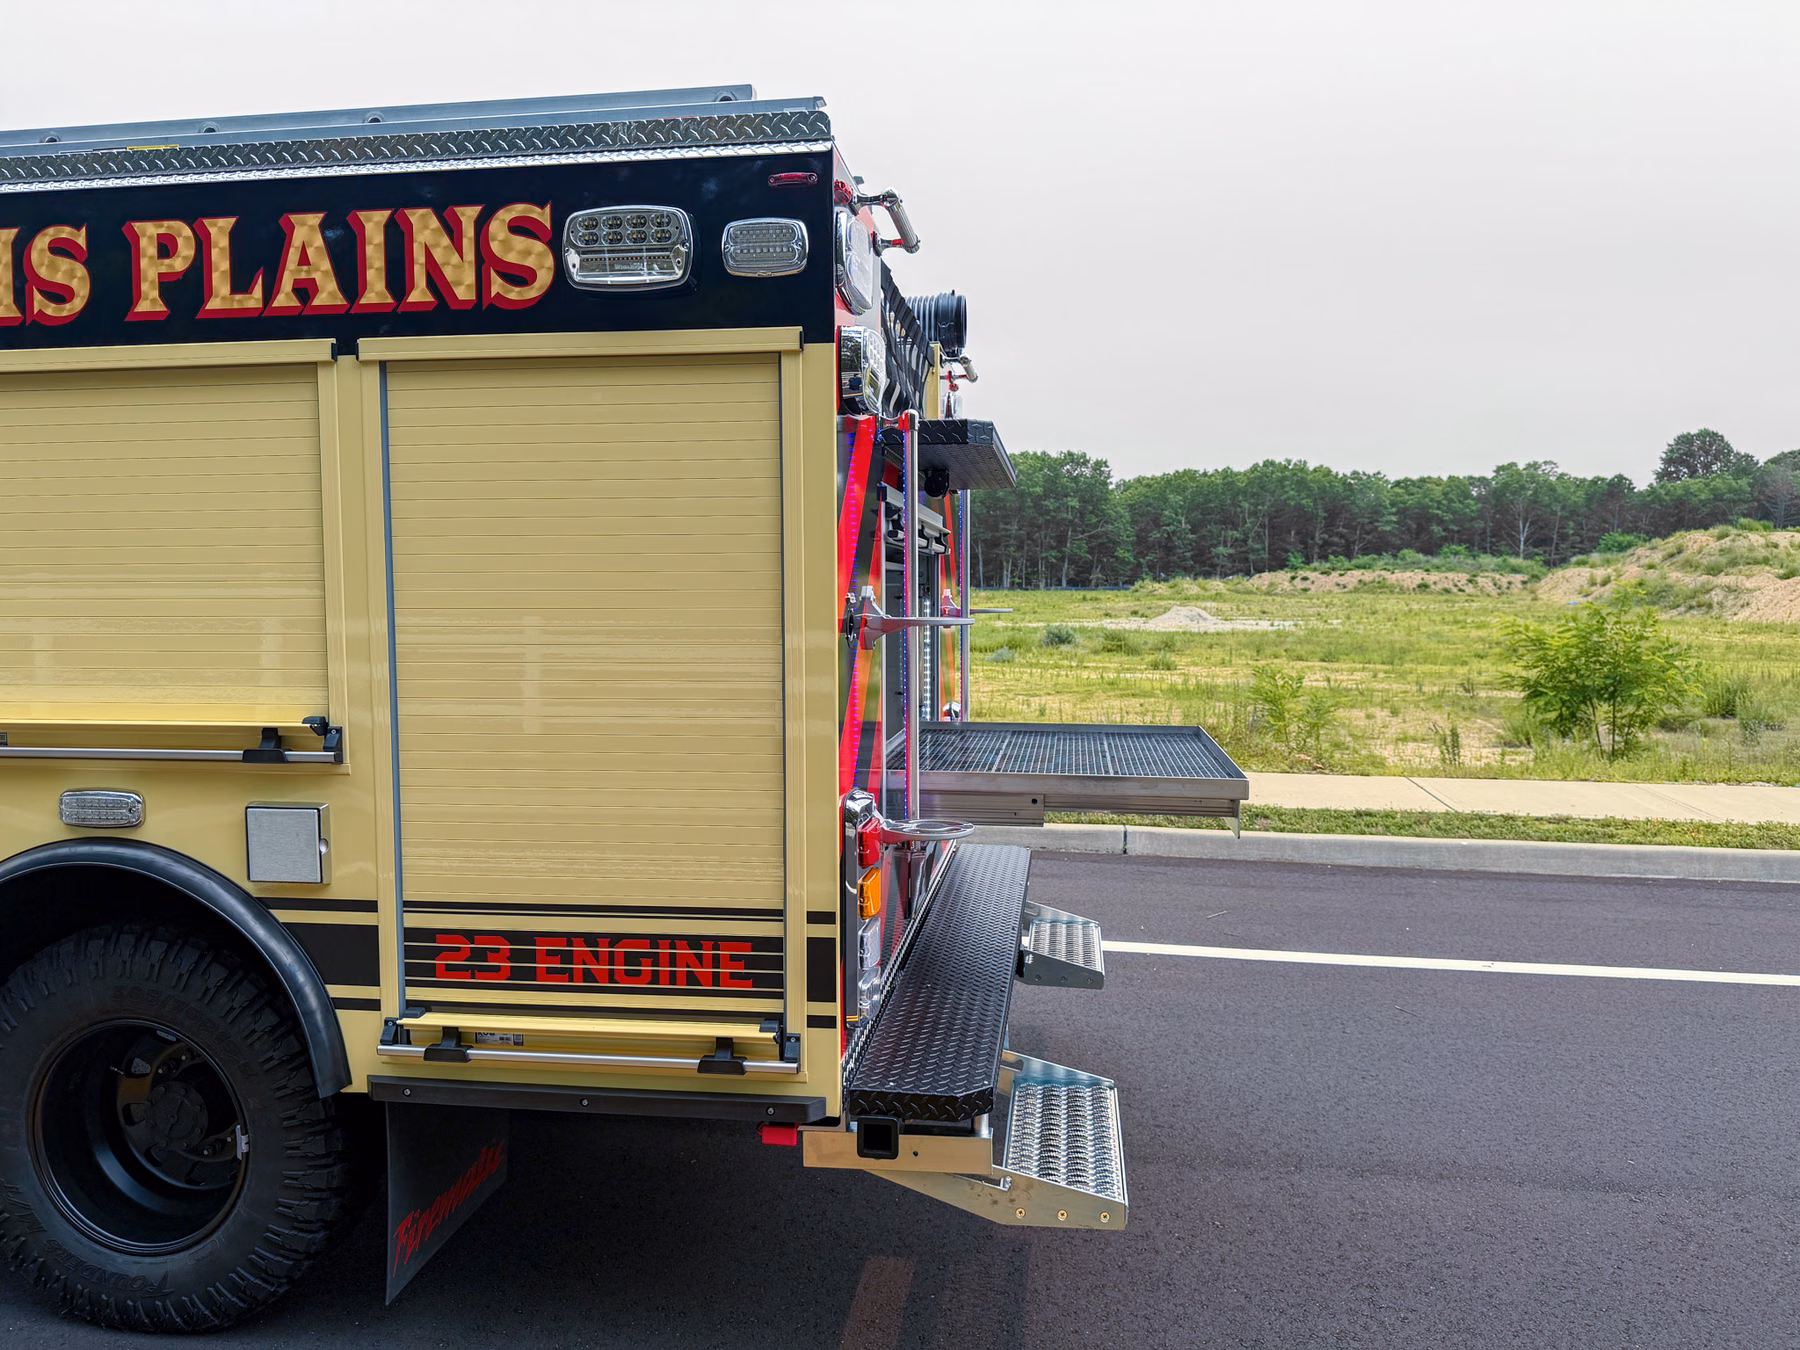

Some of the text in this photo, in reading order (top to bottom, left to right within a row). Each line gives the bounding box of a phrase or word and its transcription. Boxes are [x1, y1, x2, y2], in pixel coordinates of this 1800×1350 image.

[122, 201, 555, 321] PLAINS
[435, 934, 753, 988] 23 ENGINE
